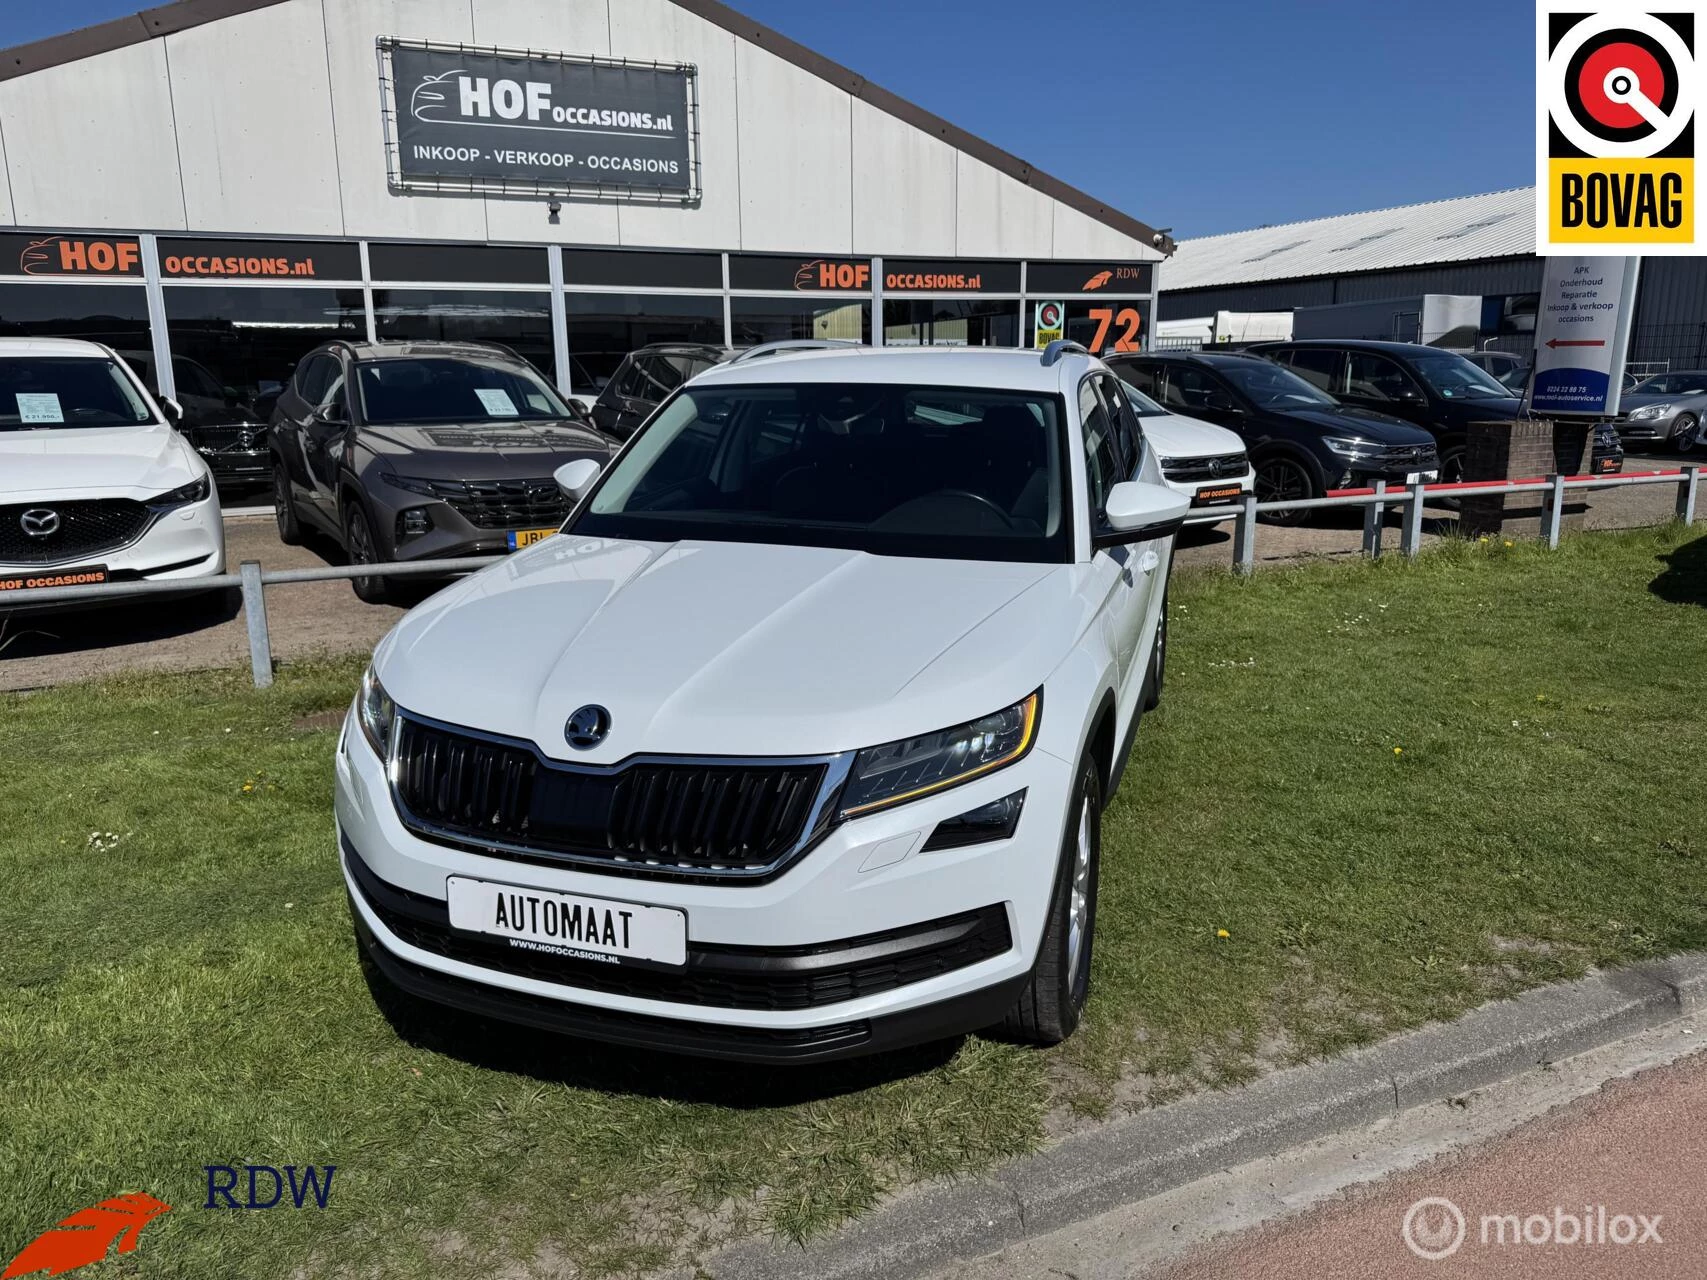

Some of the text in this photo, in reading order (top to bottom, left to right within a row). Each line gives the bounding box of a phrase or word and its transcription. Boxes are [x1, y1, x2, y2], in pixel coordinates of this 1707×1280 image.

[458, 75, 673, 131] HOF OCCASIONS.nl
[413, 145, 480, 162] INKOOP
[494, 150, 575, 168] VERKOOP
[587, 155, 679, 174] OCCASIONS
[59, 241, 315, 275] HOF OCCASIONS.nl
[819, 263, 981, 289] HOF OCCASIONS.nl
[1116, 267, 1141, 280] RDW
[1573, 266, 1590, 274] APK
[1560, 278, 1603, 288] Onderhoud
[1561, 290, 1597, 300] Reparatie
[1579, 302, 1614, 311] verkoop
[1558, 315, 1594, 323] occasions
[1089, 308, 1141, 353] 72
[26, 572, 105, 588] OCCASIONS
[496, 892, 632, 949] AUTOMAAT
[509, 938, 621, 965] WWW.HOFOCCASIONS.NL
